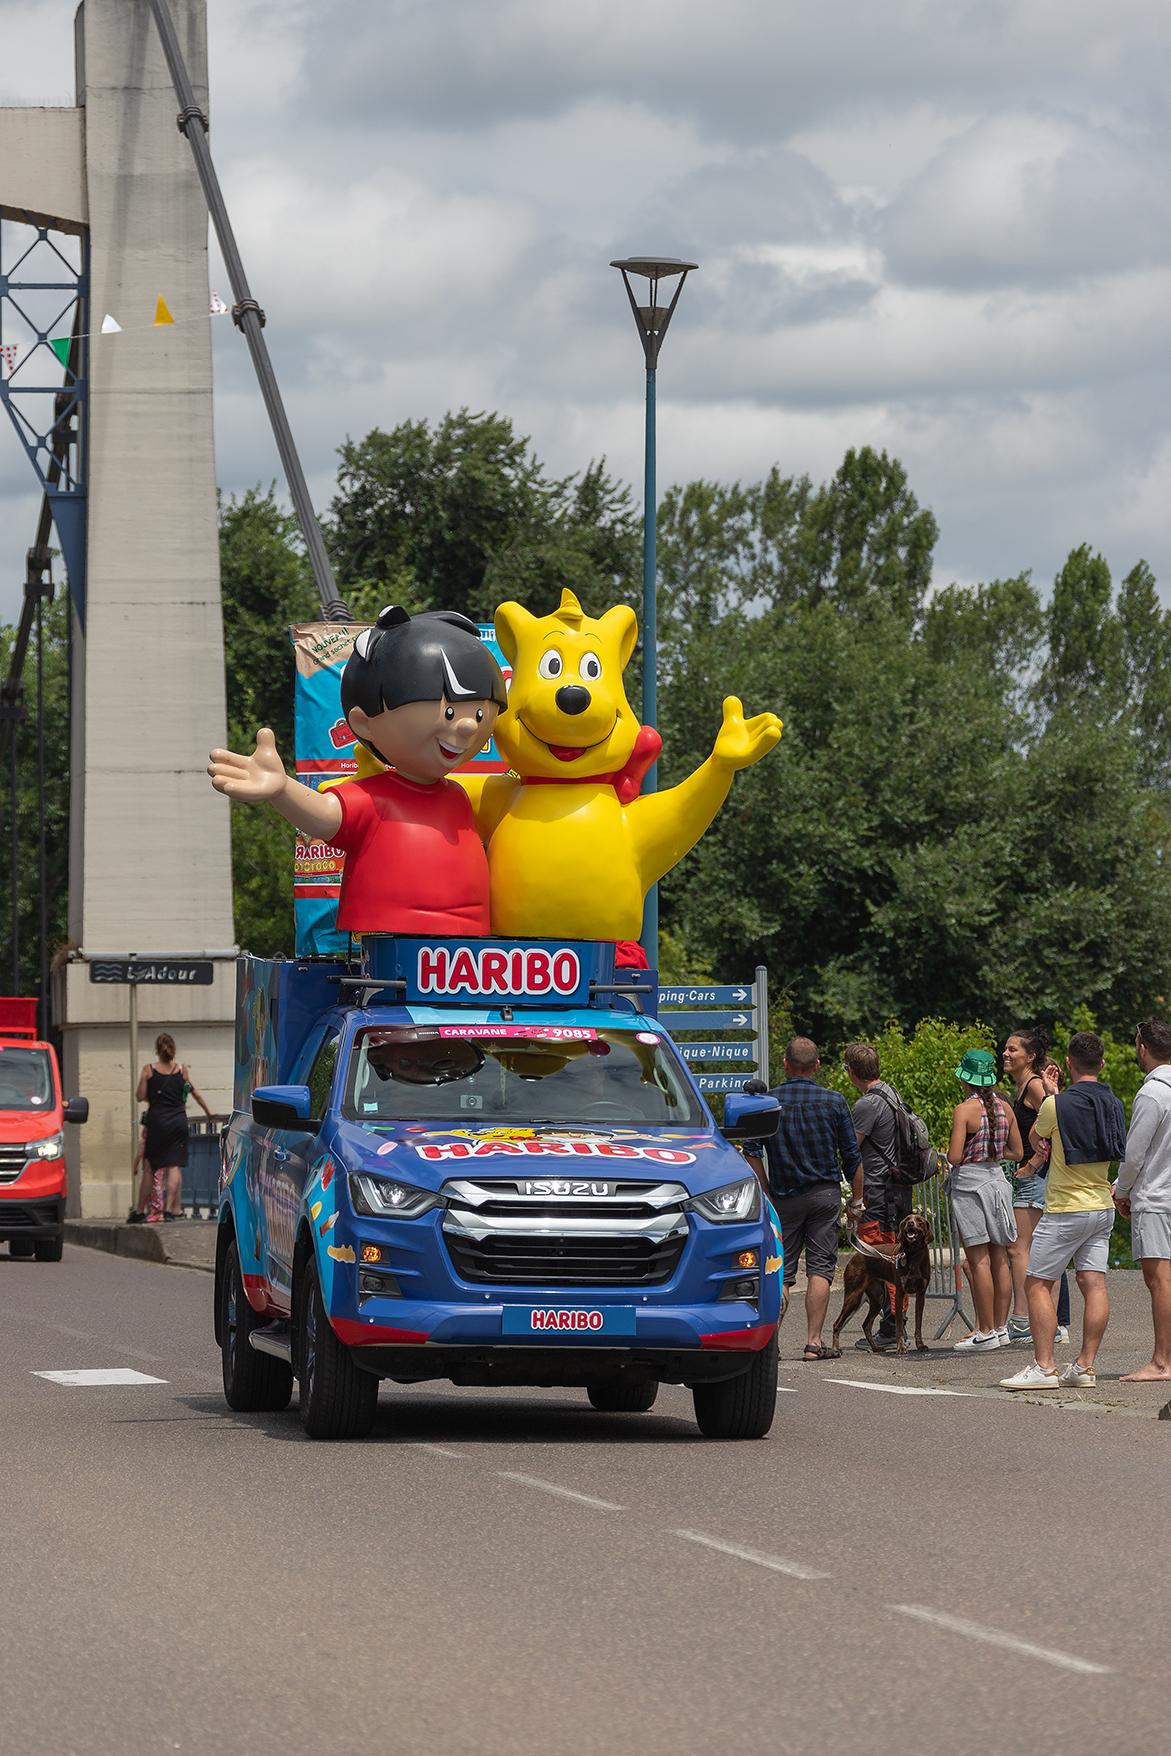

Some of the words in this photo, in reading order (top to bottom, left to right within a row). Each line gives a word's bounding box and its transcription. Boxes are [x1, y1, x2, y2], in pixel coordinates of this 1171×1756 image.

[417, 947, 580, 995] HARIBO
[658, 990, 716, 1004] ping-Cars
[443, 1028, 508, 1036] CARAVANE
[552, 1028, 592, 1039] 9085
[679, 1046, 749, 1060] ique-Nique
[698, 1077, 750, 1089] Parkin
[415, 1140, 697, 1165] HARIBO
[525, 1181, 609, 1196] ISUZU
[530, 1309, 604, 1331] HARIBO
